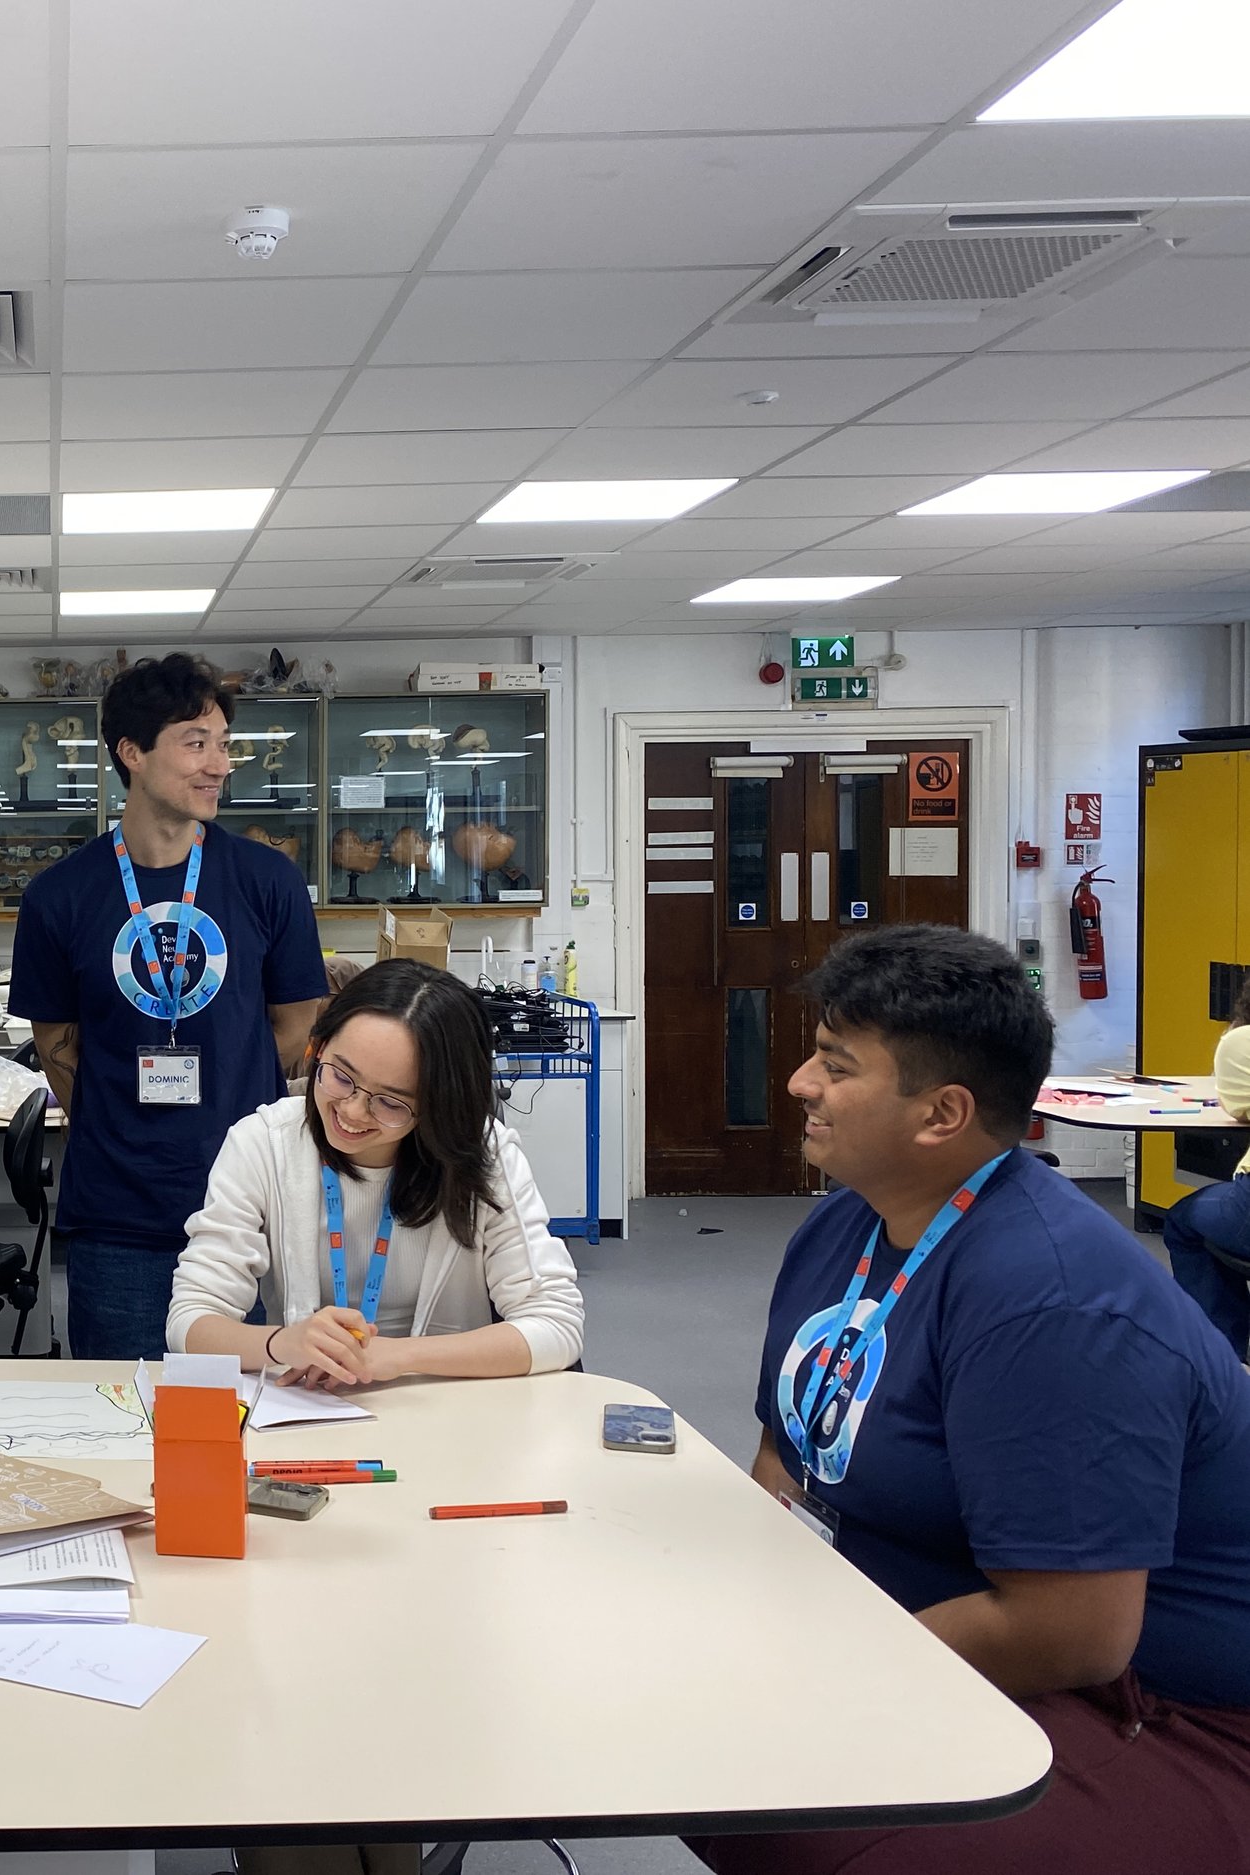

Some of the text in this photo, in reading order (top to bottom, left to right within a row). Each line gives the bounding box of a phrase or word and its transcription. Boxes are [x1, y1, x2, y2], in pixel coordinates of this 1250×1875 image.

[913, 800, 925, 808] No
[926, 800, 943, 808] food
[148, 1075, 190, 1084] DOMINIC
